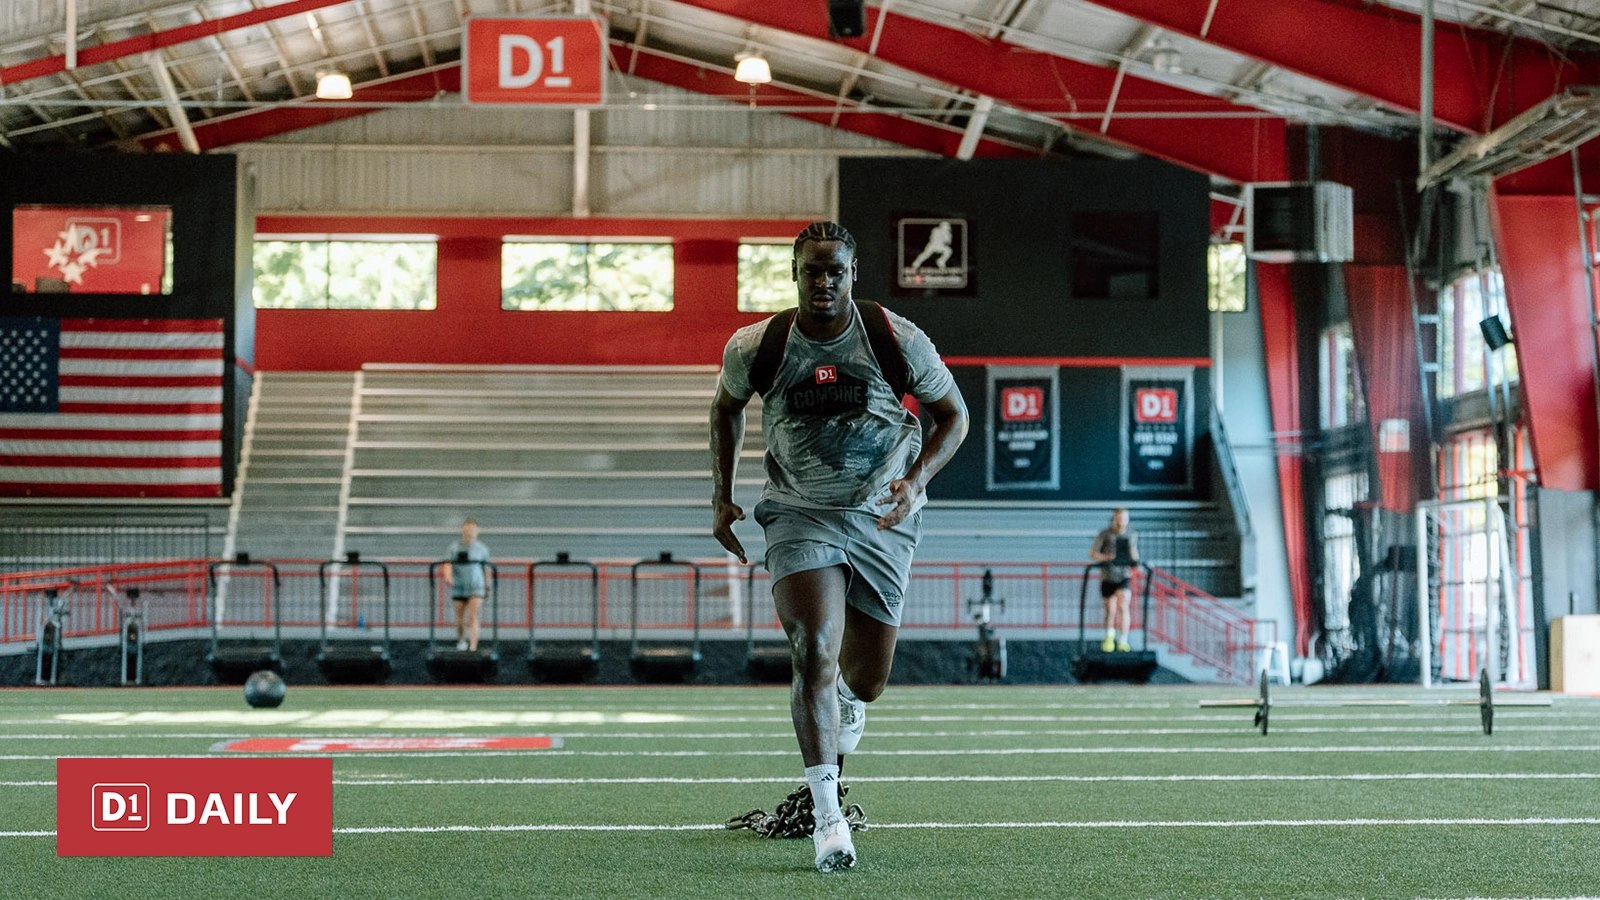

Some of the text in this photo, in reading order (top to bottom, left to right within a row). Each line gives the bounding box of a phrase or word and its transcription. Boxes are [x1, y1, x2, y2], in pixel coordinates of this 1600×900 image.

[499, 34, 571, 87] D1
[818, 369, 834, 381] D1
[793, 385, 862, 409] COMBINE
[1008, 393, 1039, 416] D1
[1141, 394, 1173, 417] D1
